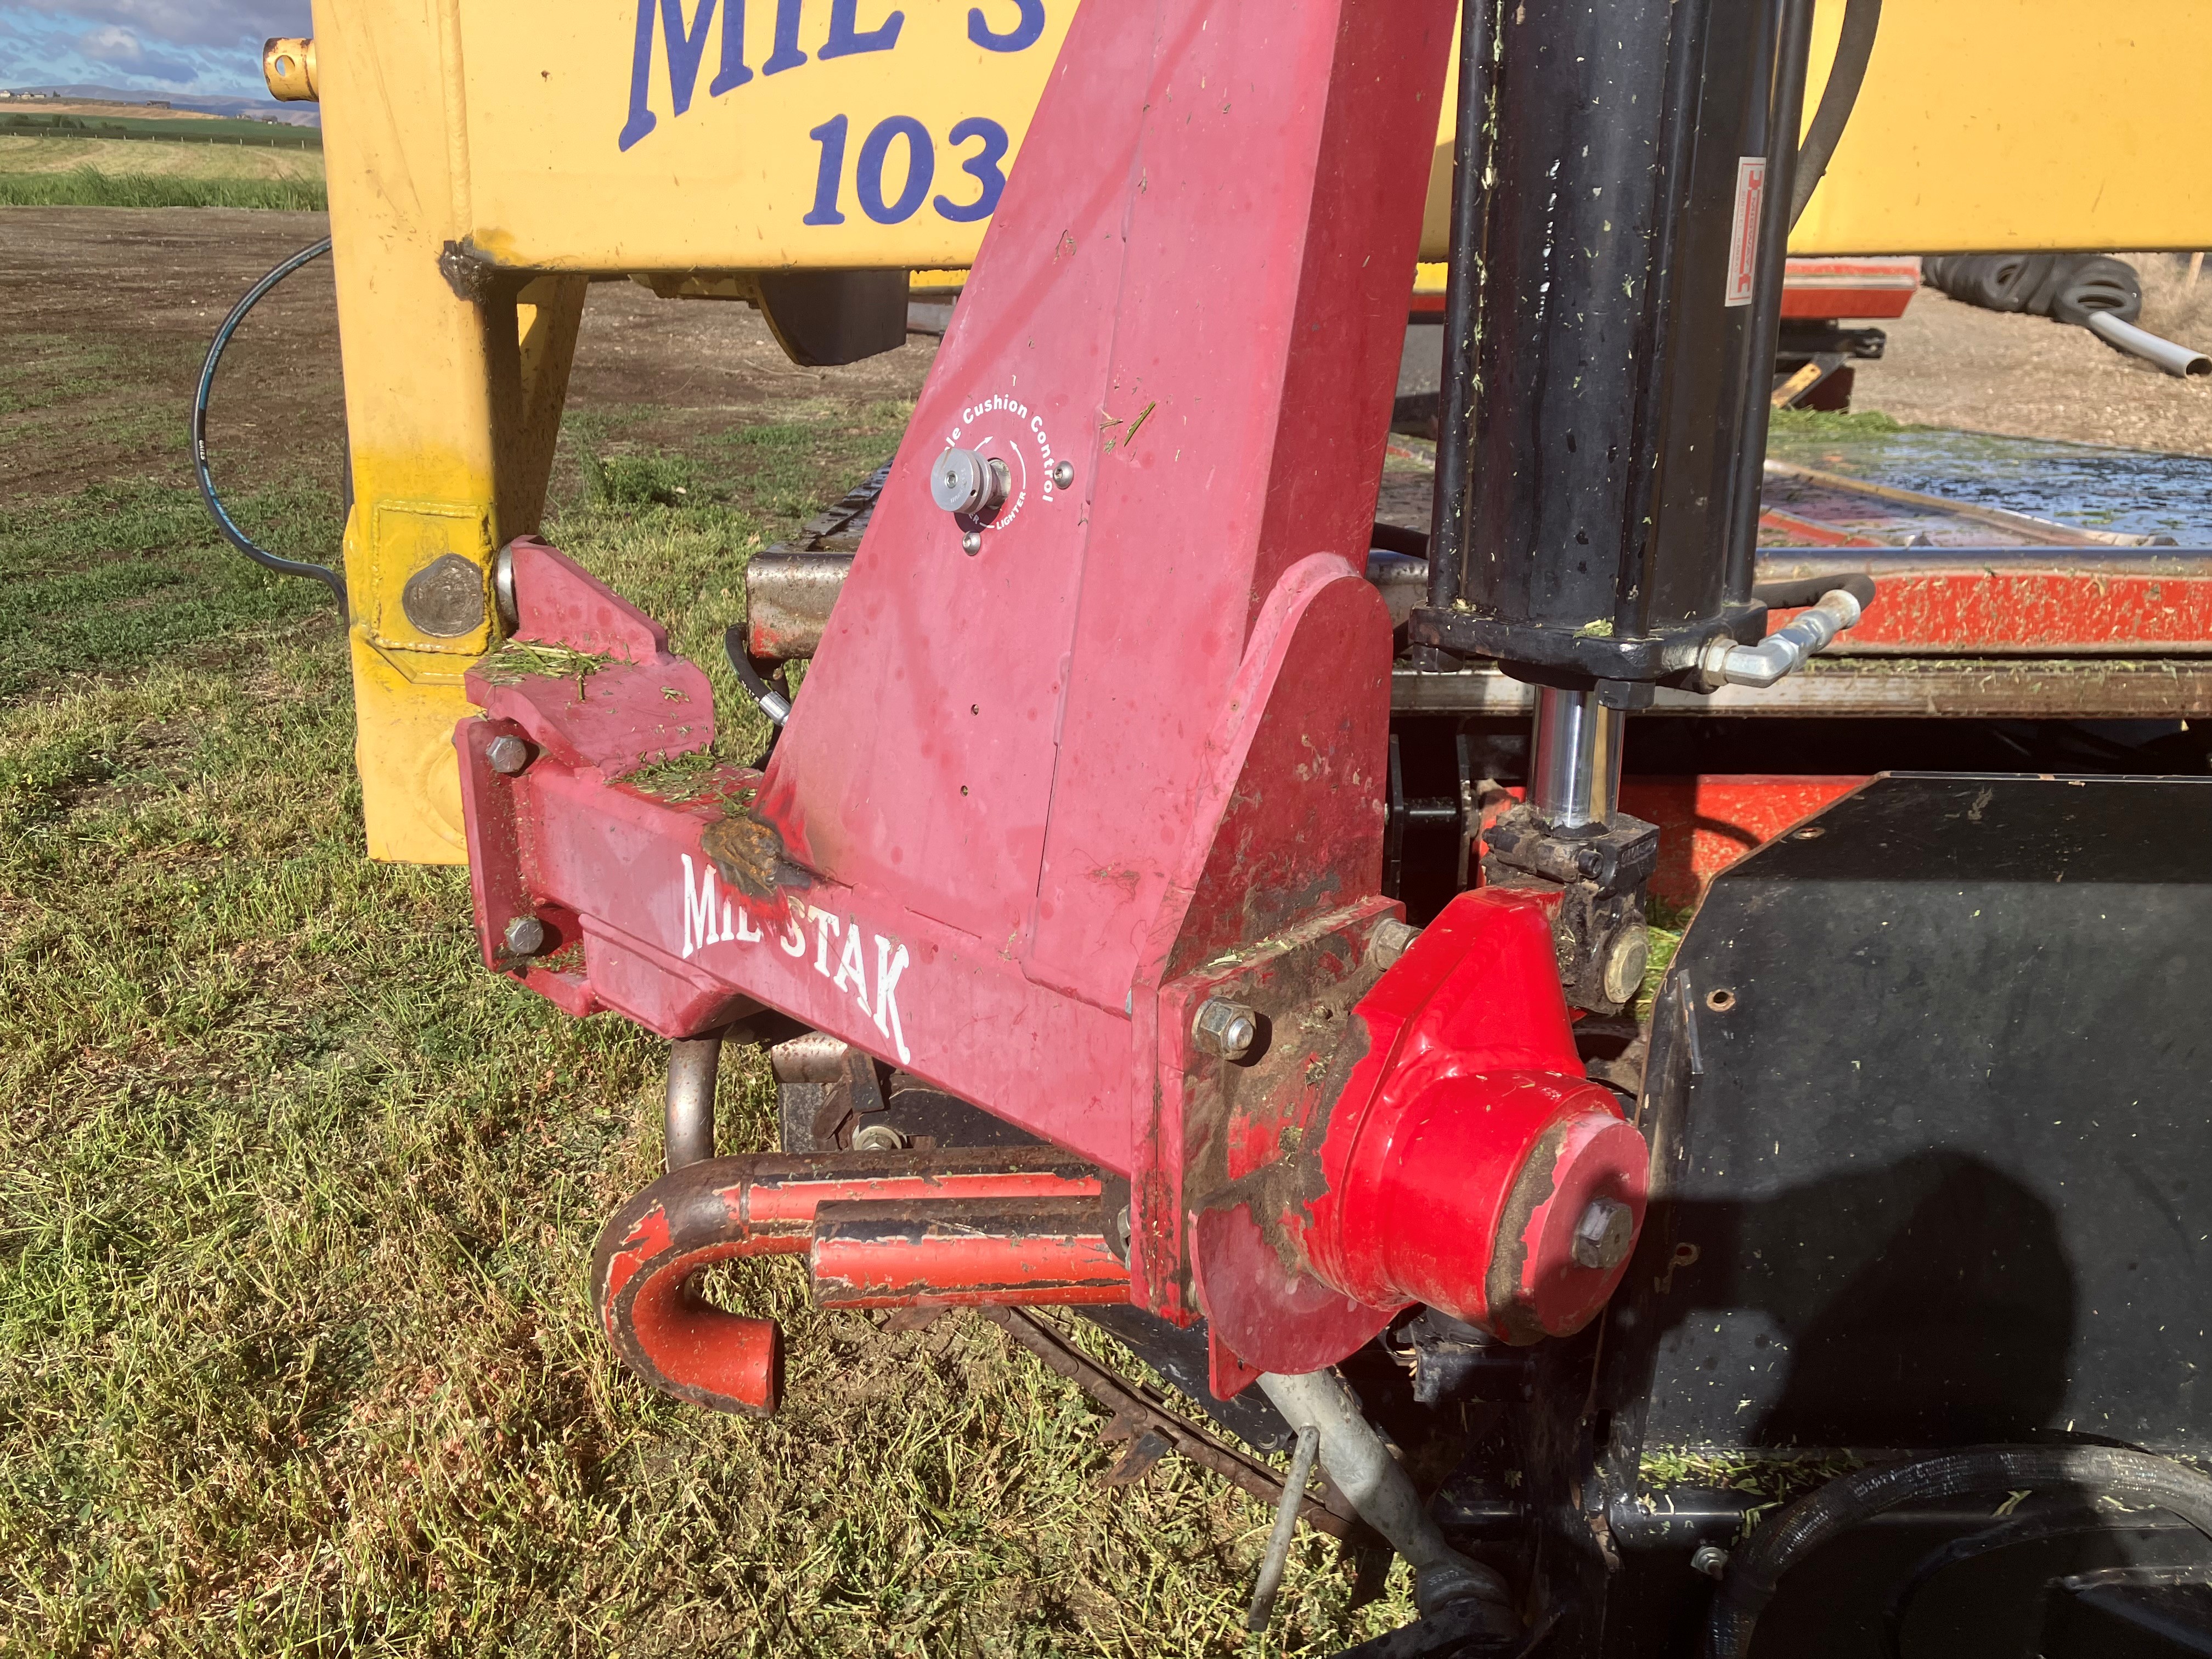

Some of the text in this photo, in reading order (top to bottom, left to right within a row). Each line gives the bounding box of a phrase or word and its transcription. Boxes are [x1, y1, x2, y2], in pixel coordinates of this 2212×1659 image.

[963, 394, 1028, 424] Cushion
[1031, 415, 1055, 502] Control
[996, 491, 1026, 531] LIGHTER
[780, 895, 911, 1065] STAK
